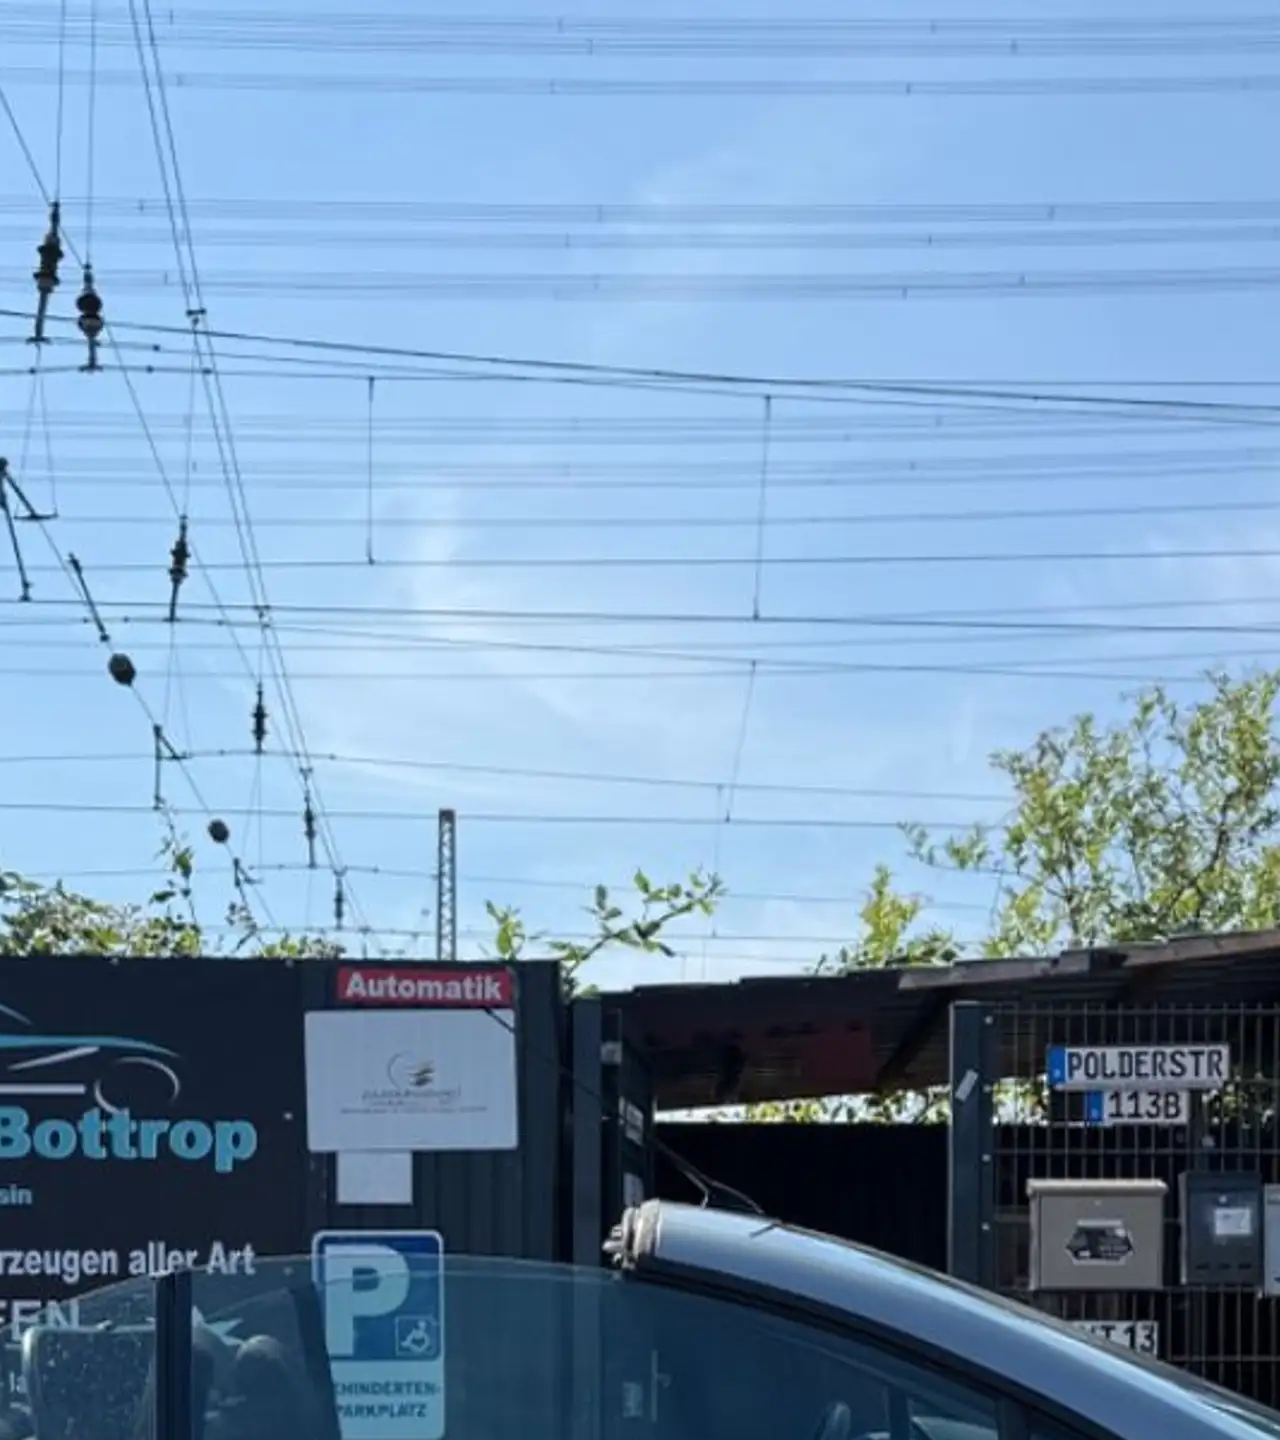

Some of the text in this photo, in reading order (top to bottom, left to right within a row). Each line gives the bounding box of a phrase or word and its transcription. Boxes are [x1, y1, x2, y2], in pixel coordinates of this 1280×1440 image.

[345, 972, 503, 1000] Automatik
[1067, 1047, 1223, 1080] POLDERSTR
[128, 1240, 198, 1276] aller
[206, 1240, 256, 1276] Art
[325, 1243, 410, 1357] P
